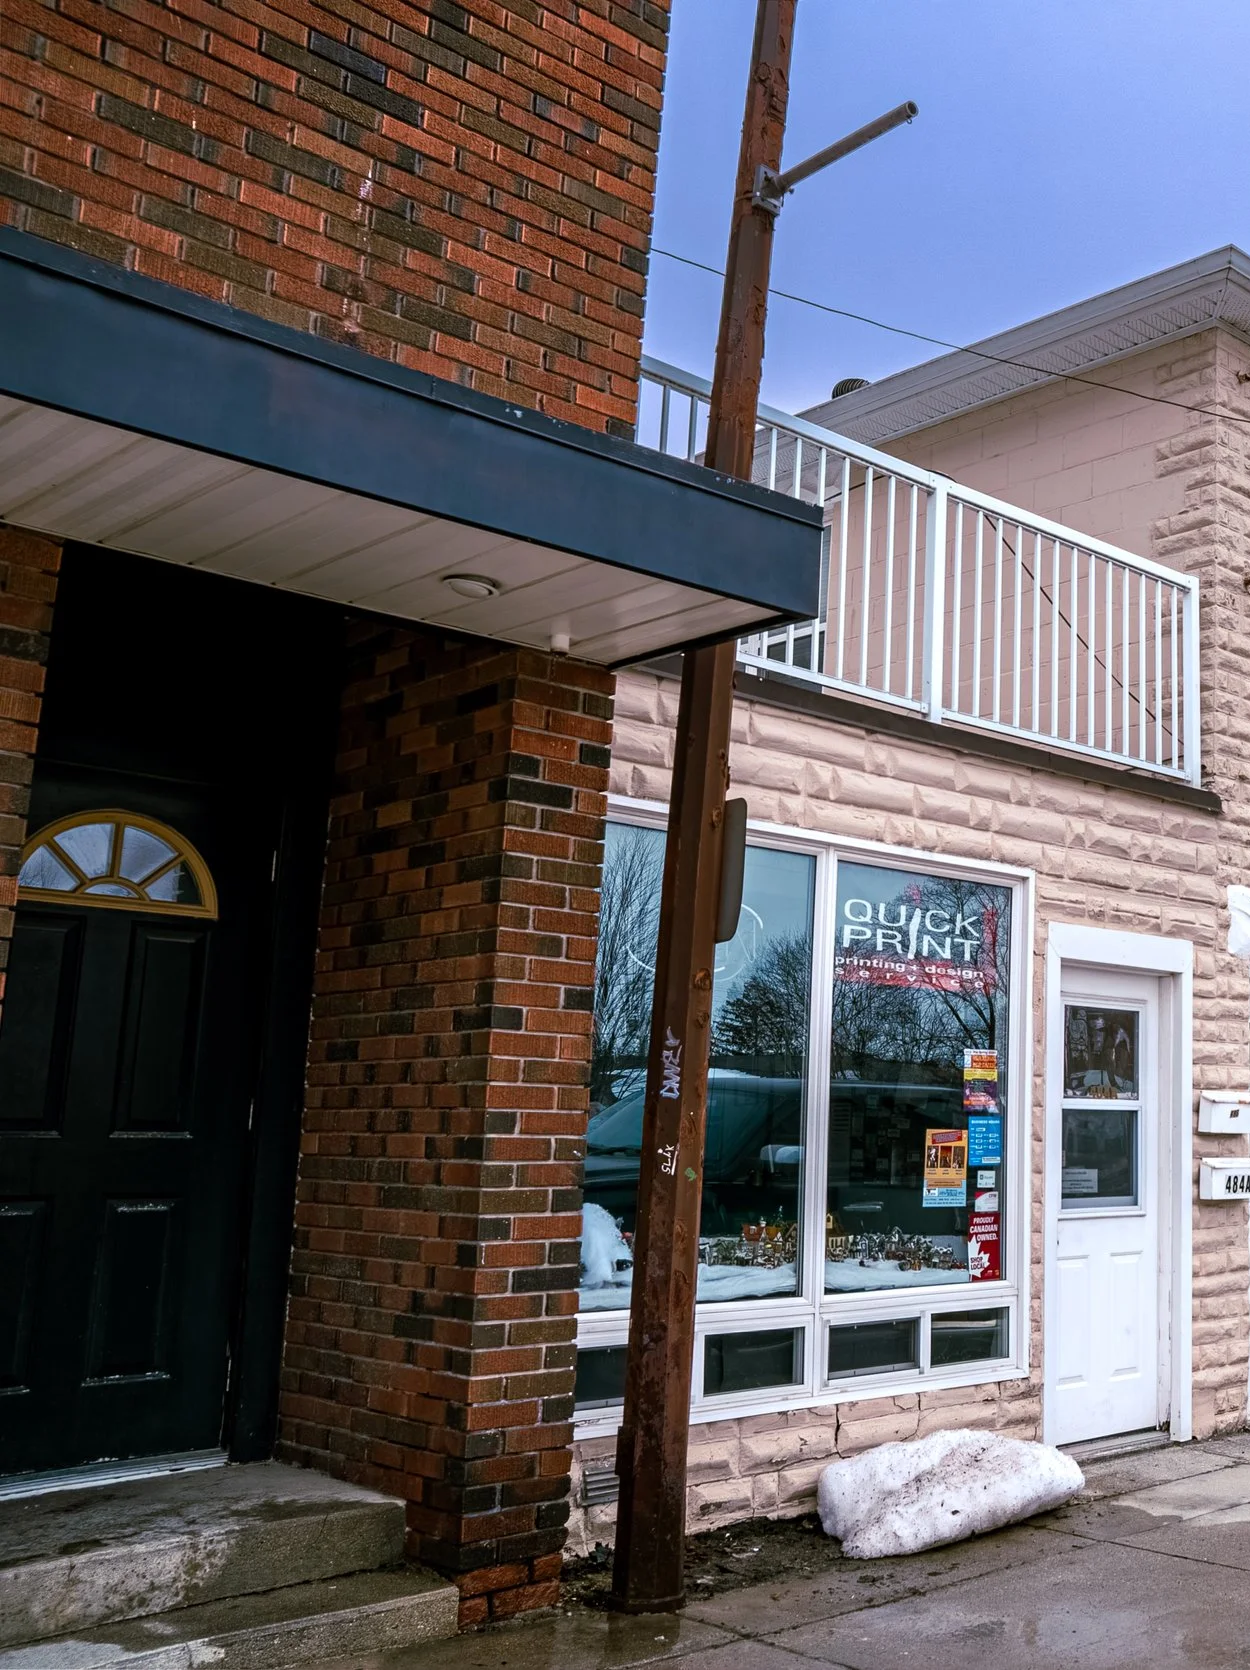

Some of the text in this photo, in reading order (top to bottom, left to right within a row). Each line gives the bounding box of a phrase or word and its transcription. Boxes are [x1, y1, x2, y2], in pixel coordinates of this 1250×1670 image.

[843, 898, 981, 938] QUICK
[842, 924, 981, 962] PRINT
[834, 955, 906, 973] printing
[924, 964, 984, 980] design
[834, 967, 984, 989] service
[1225, 1175, 1250, 1194] 484A
[969, 1224, 999, 1234] CANADIAN
[973, 1216, 994, 1225] PROUDLY
[970, 1256, 984, 1264] SHOP
[970, 1262, 986, 1271] LOCAL
